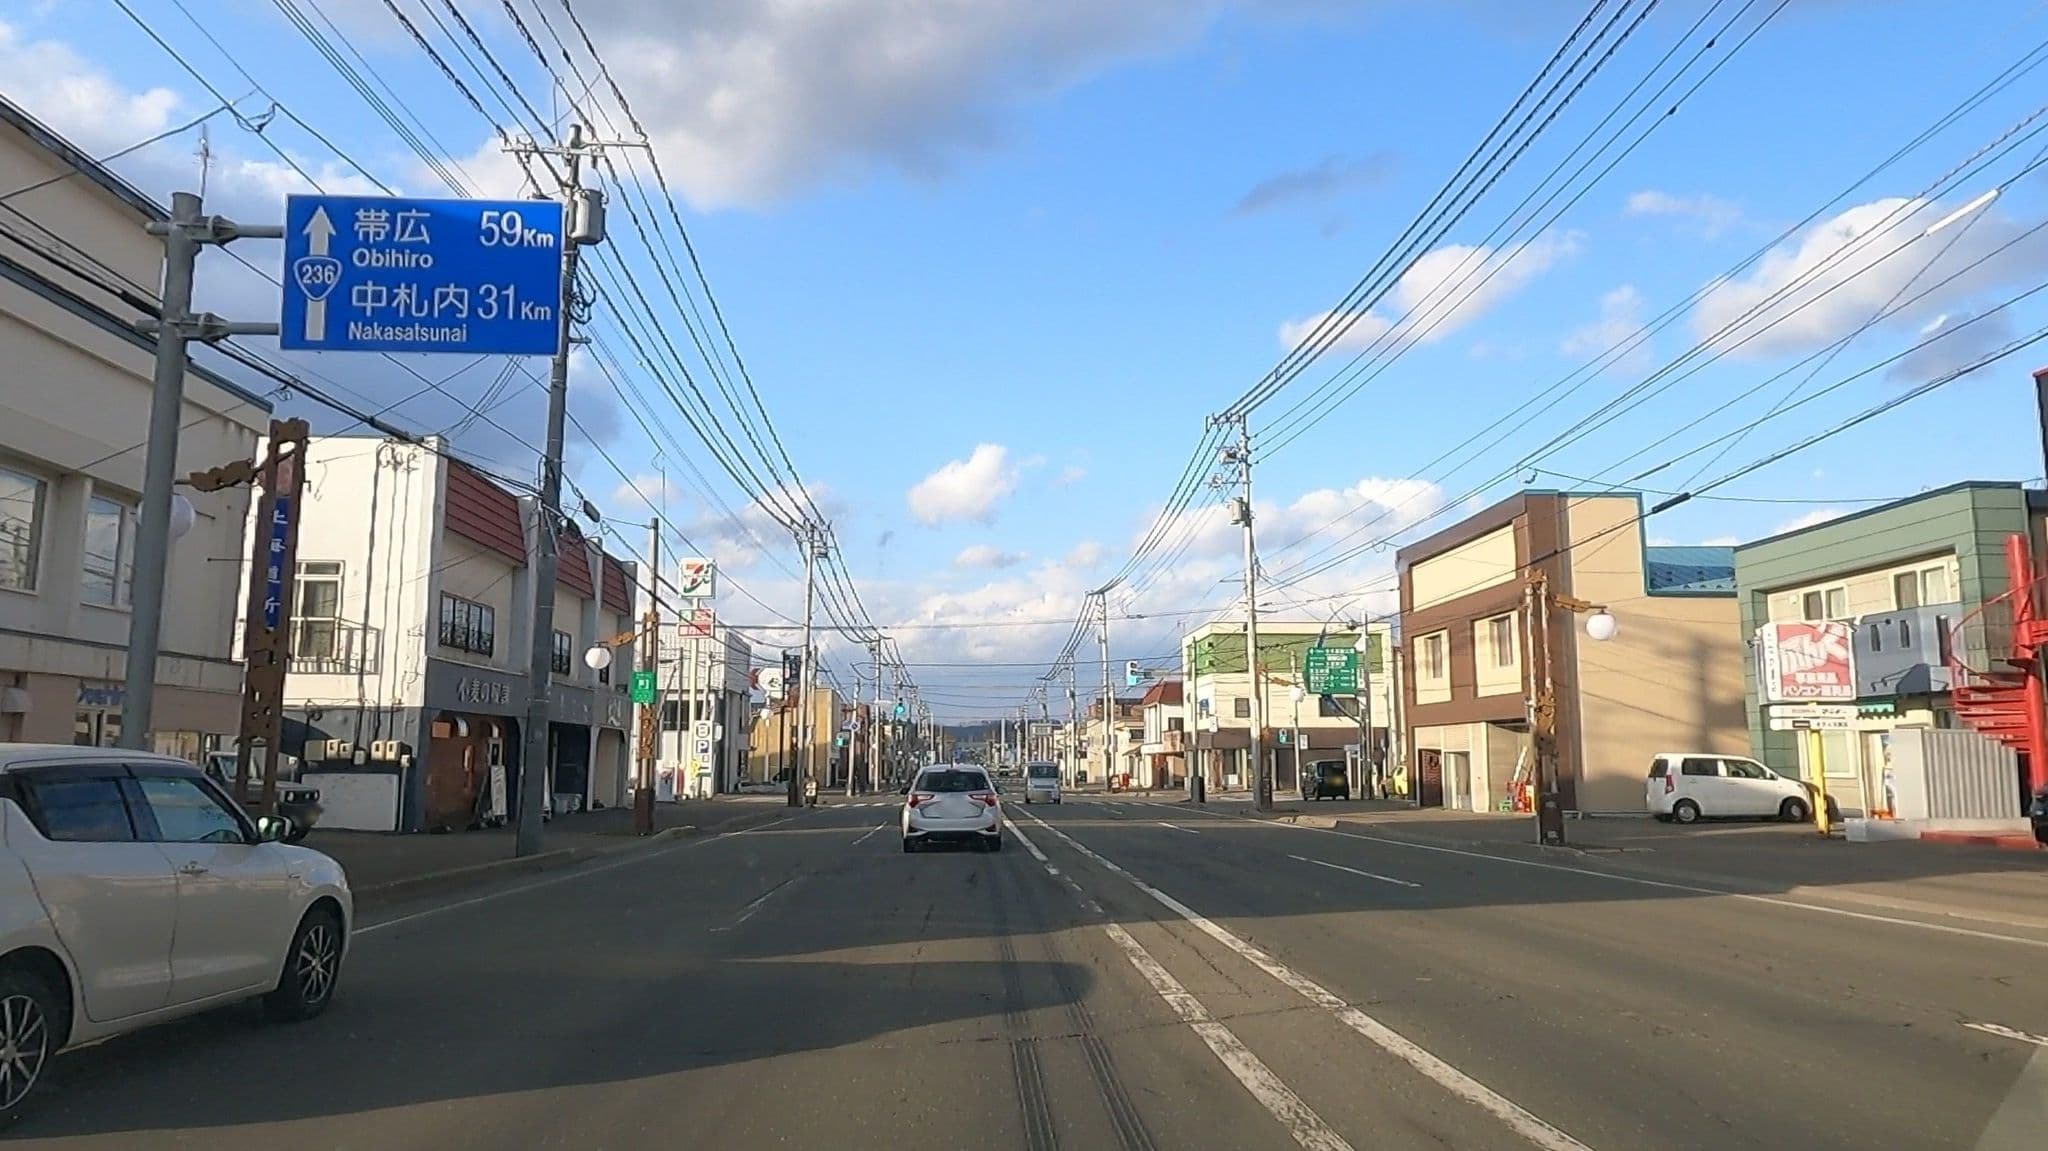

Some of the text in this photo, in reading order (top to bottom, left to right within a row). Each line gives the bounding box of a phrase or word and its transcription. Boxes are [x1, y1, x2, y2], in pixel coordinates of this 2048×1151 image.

[353, 208, 431, 244] 帯広
[352, 248, 433, 269] Obihiro
[302, 265, 335, 285] 236
[352, 280, 469, 319] 中札内
[348, 321, 468, 343] Nakasatsunai
